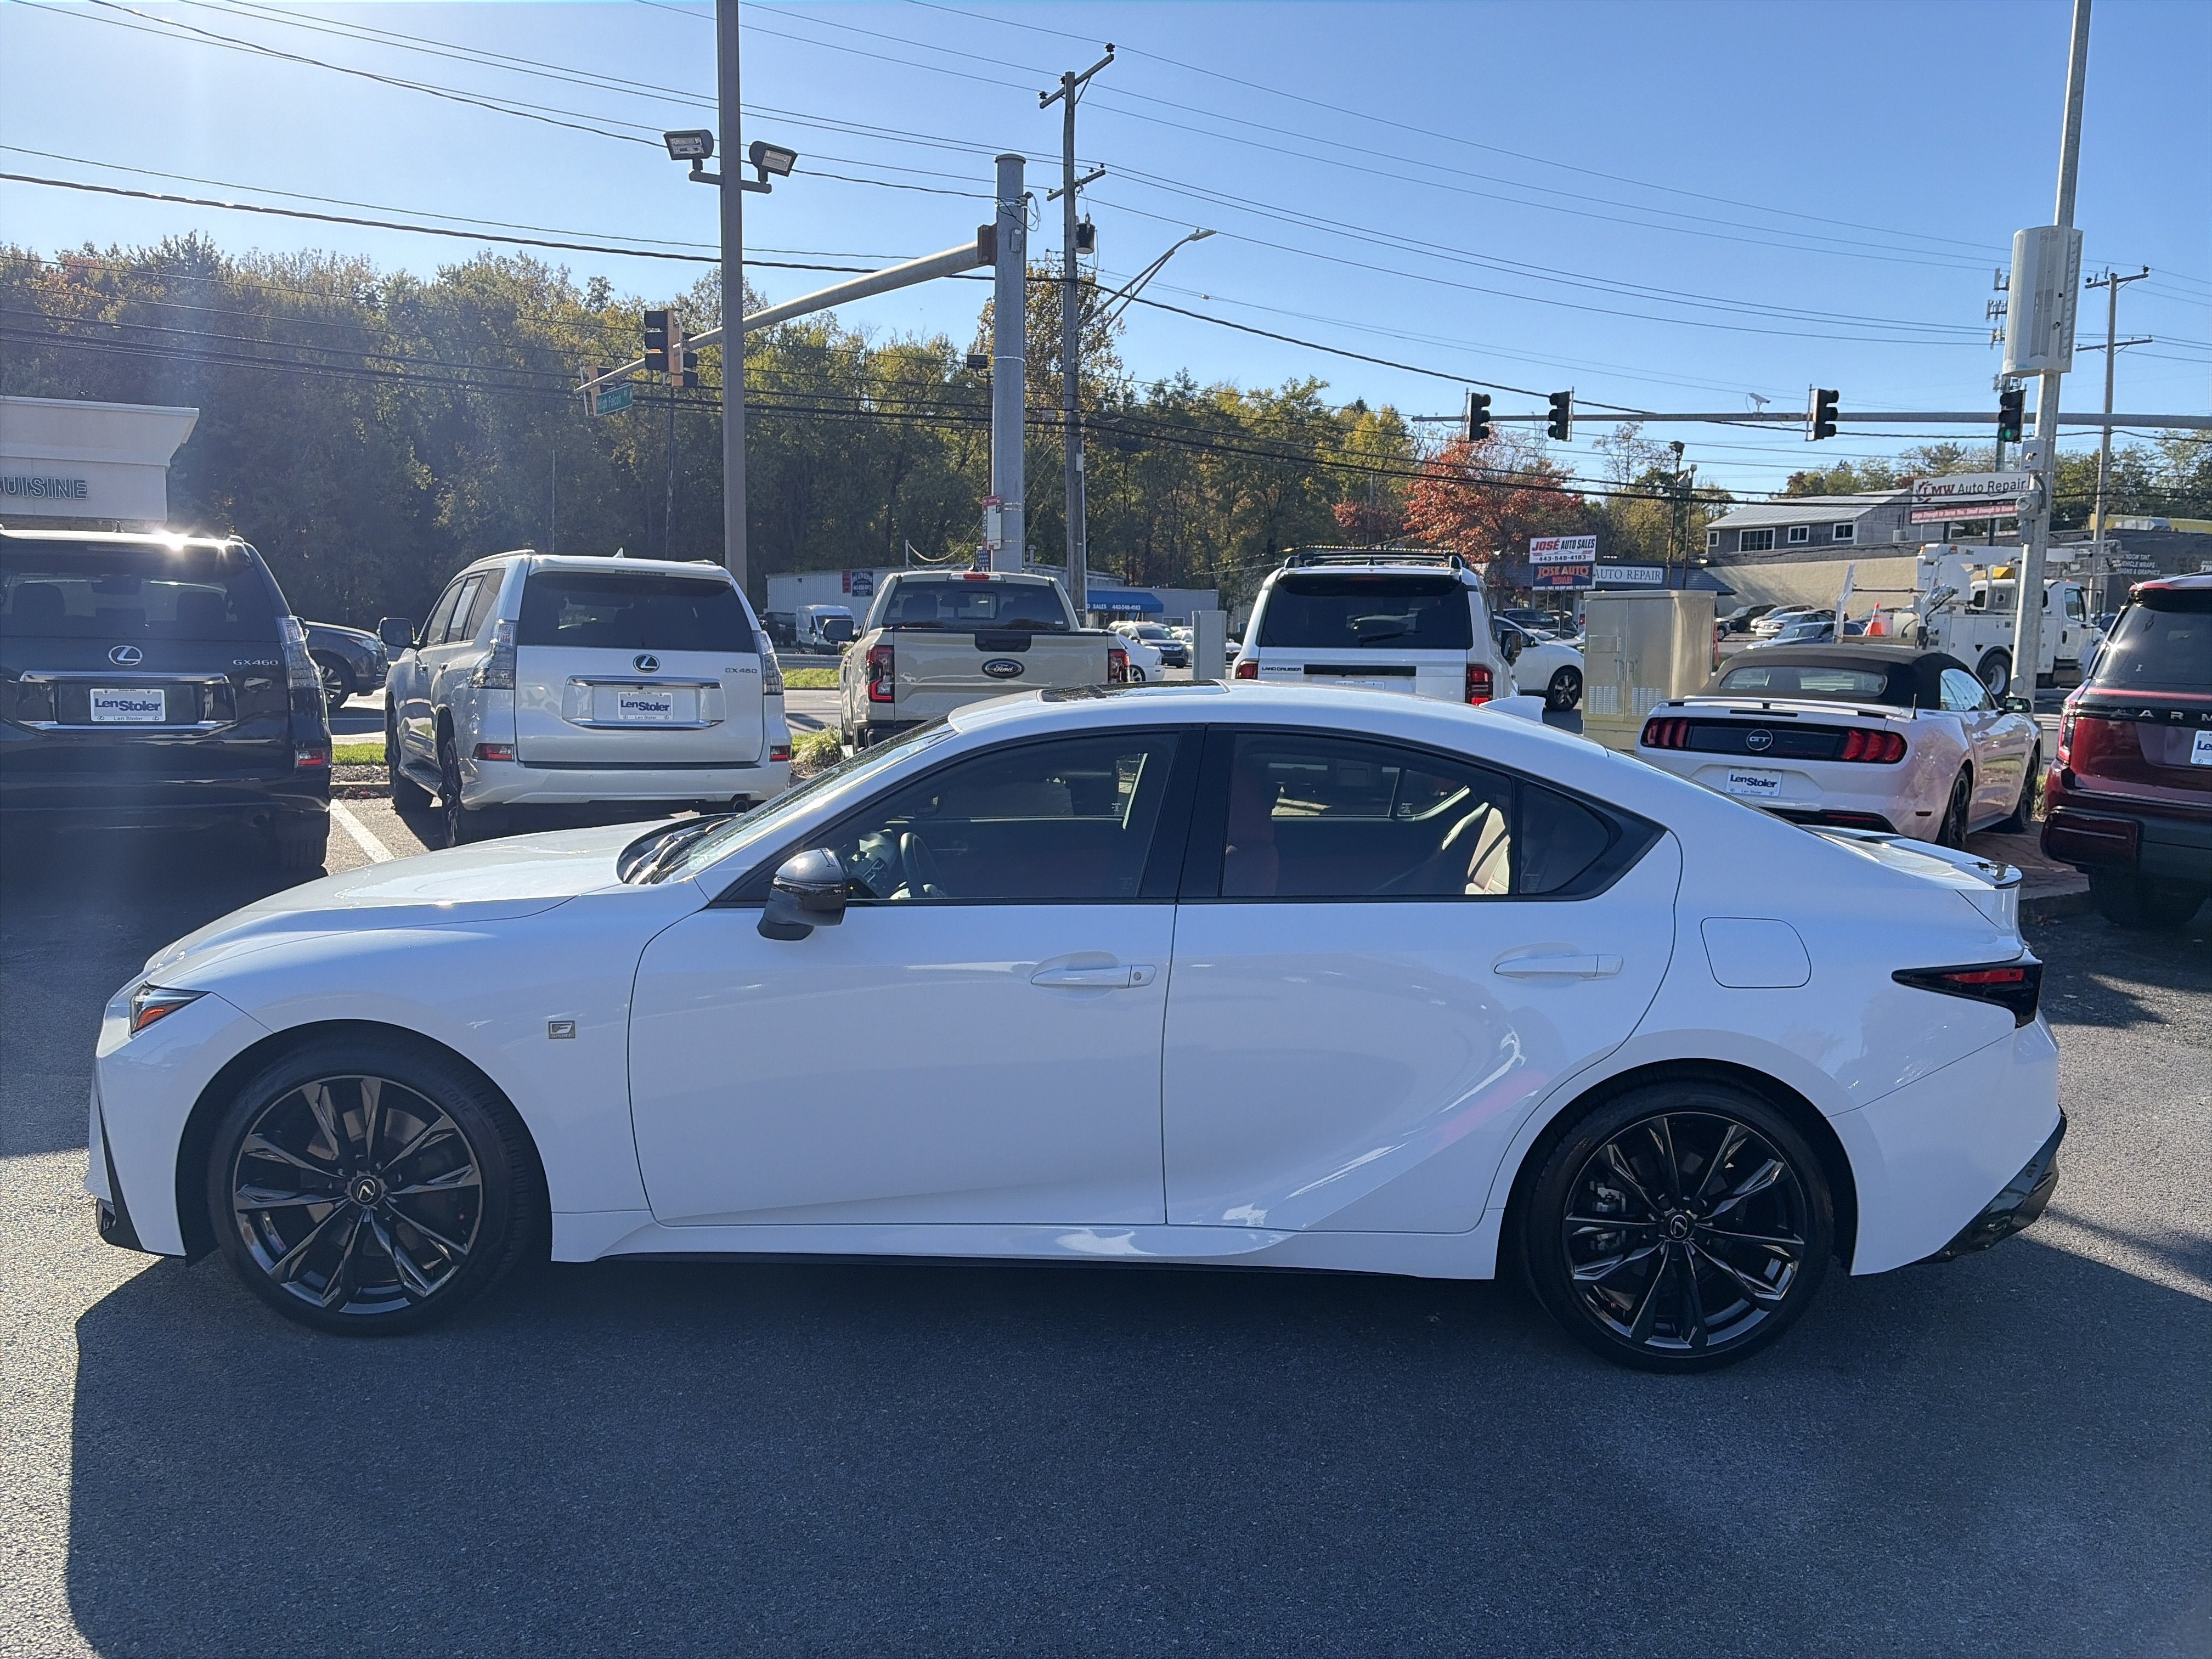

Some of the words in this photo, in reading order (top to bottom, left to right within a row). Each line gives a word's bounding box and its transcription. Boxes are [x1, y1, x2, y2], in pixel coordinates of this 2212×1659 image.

[0, 476, 88, 500] UISINE
[1957, 483, 1984, 494] Auto
[1988, 478, 2027, 493] Repair
[1532, 538, 1560, 551] JOSÉ
[1560, 539, 1577, 550] AUTO
[1577, 538, 1595, 549] SALES
[1537, 566, 1560, 579] JOSE
[1561, 565, 1590, 577] AUTO
[1595, 568, 1622, 579] AUTO
[1627, 569, 1661, 580] REPAIR
[994, 664, 1014, 673] Ford
